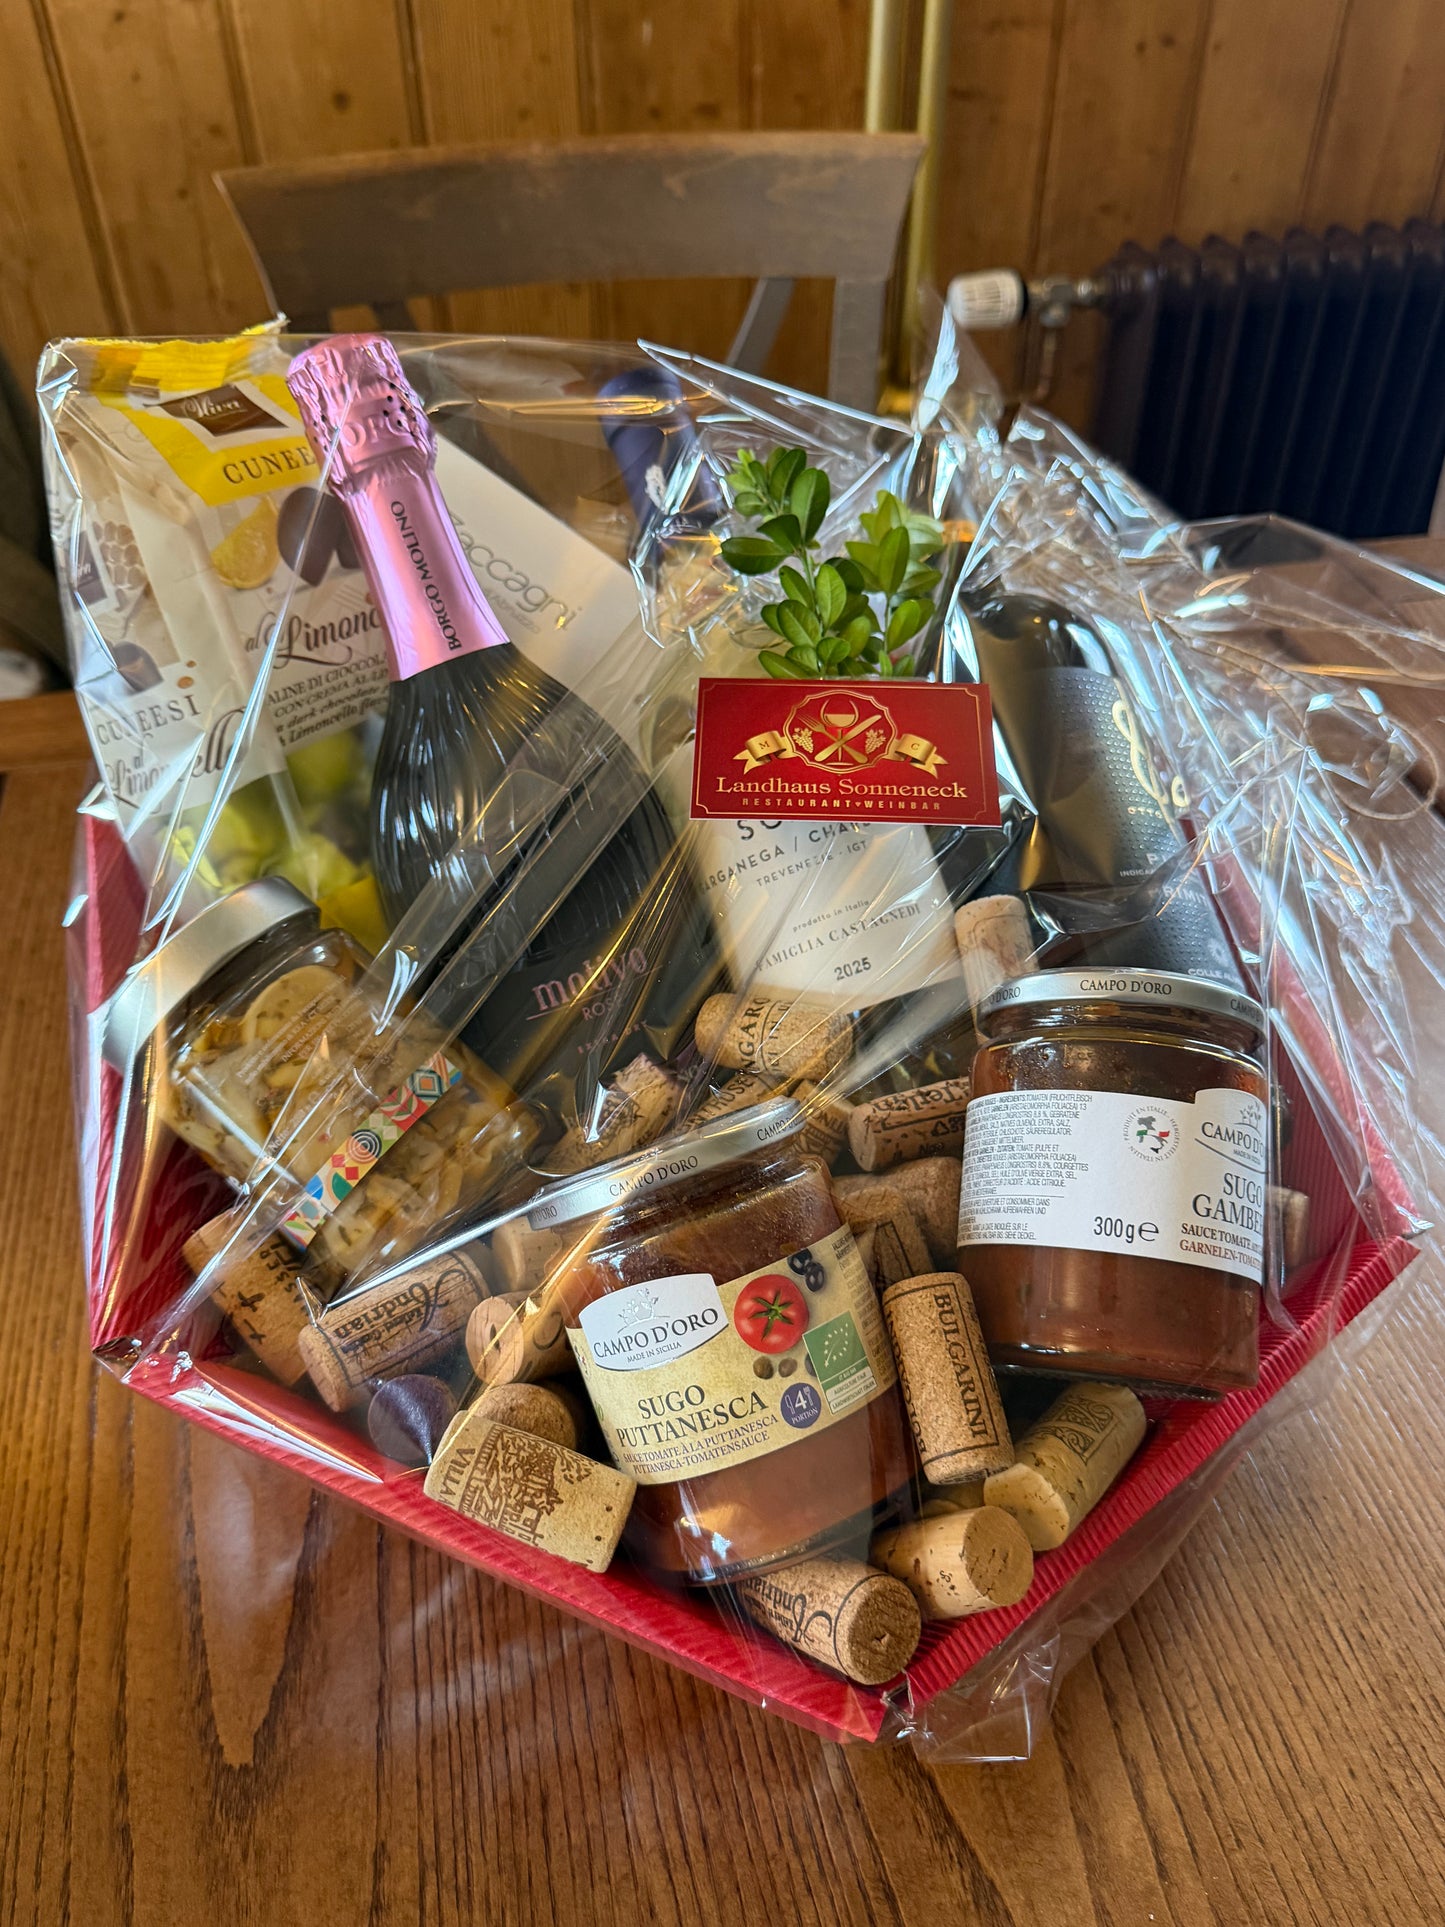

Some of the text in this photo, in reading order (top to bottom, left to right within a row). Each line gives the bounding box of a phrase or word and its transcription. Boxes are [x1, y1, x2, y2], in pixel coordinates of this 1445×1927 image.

[389, 500, 461, 650] BORGO MOLINO
[760, 741, 770, 750] M
[910, 742, 920, 750] C
[715, 777, 967, 798] Landhaus Sonneneck
[864, 800, 941, 810] WEINBAR
[847, 840, 867, 854] IGT
[756, 938, 824, 972] FAMIGLIA
[834, 956, 872, 981] 2025
[532, 947, 648, 1011] motivo
[1079, 979, 1172, 995] CAMPO D'ORO
[1052, 1144, 1059, 1152] ET
[1201, 1121, 1252, 1150] CAMPO
[609, 1155, 699, 1197] CAMPO D'ORO
[1053, 1162, 1089, 1172] COURGETTES
[1223, 1172, 1262, 1208] SUGO
[1181, 1222, 1217, 1241] SAUCE
[1219, 1229, 1251, 1251] TOMATE
[593, 1307, 719, 1358] CAMPO D'ORO
[627, 1341, 682, 1363] MADE IN SICILIA
[934, 1293, 989, 1439] BULGARINI
[638, 1384, 706, 1420] SUGO
[795, 1390, 807, 1409] 4
[615, 1390, 769, 1448] PUTTANESCA
[791, 1406, 818, 1424] PORTION
[633, 1430, 770, 1474] PUTTANESCA-TOMATENSAUCE
[644, 1447, 681, 1462] TOMATE
[681, 1442, 690, 1454] À
[690, 1439, 704, 1452] LA
[704, 1414, 779, 1448] PUTTANESCA
